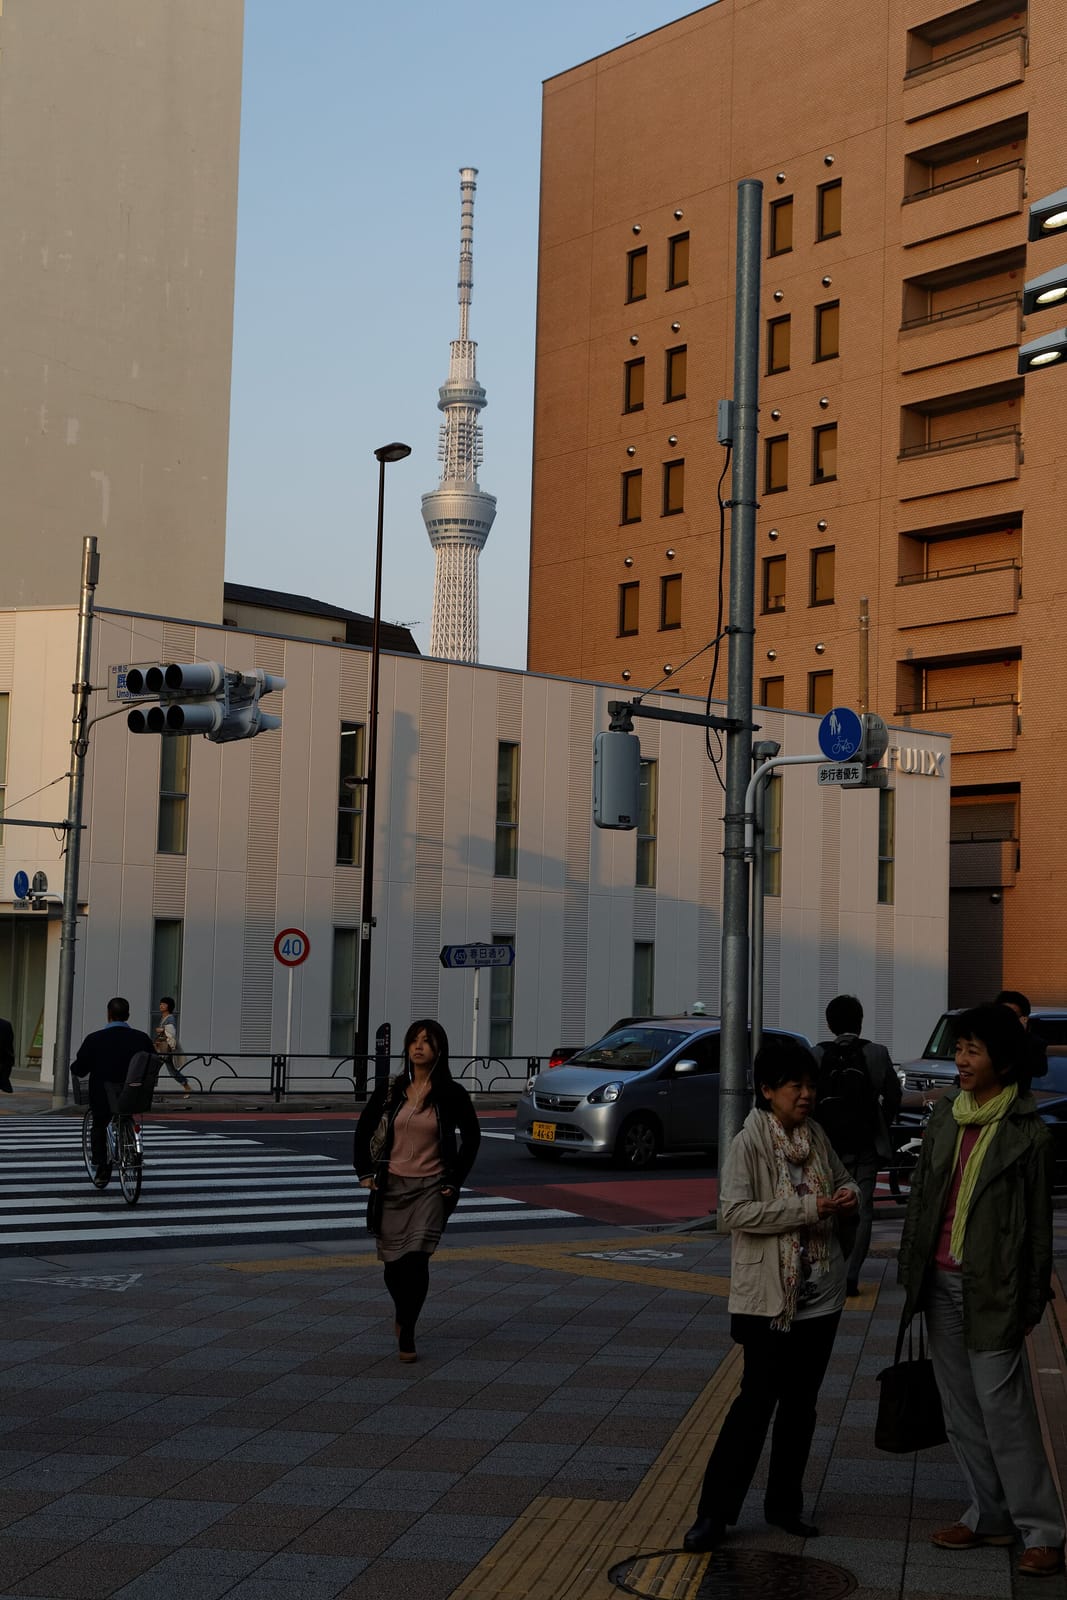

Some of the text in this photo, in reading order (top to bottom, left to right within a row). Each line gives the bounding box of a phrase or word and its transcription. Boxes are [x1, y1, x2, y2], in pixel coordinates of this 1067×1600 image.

[883, 746, 945, 777] FUJIX
[820, 768, 859, 782] 歩行者優先
[282, 939, 302, 956] 40
[470, 948, 505, 959] 春日通り
